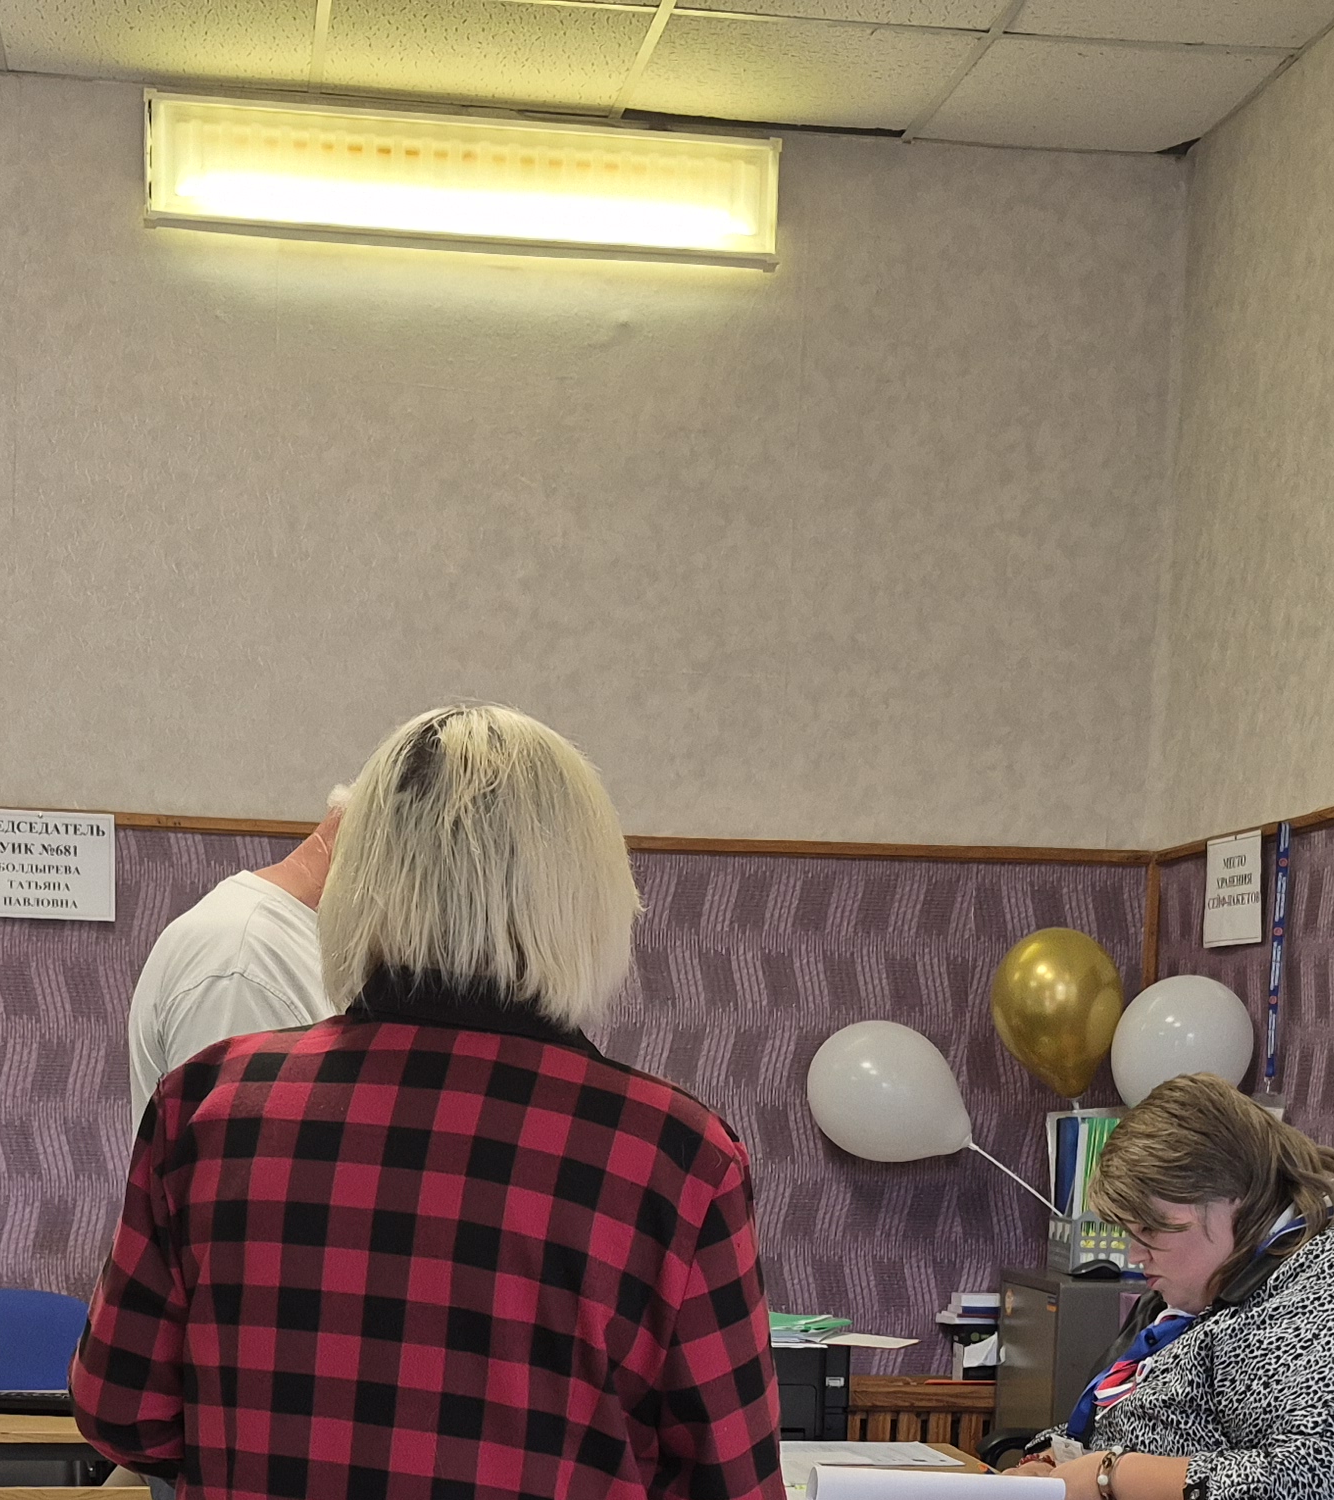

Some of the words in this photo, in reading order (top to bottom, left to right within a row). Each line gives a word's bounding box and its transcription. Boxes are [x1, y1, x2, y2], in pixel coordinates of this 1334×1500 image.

[0, 841, 35, 855] УИК
[38, 843, 78, 858] №681
[7, 879, 71, 892] ТАТЬЯНА
[3, 896, 78, 909] ПАВЛОВНА
